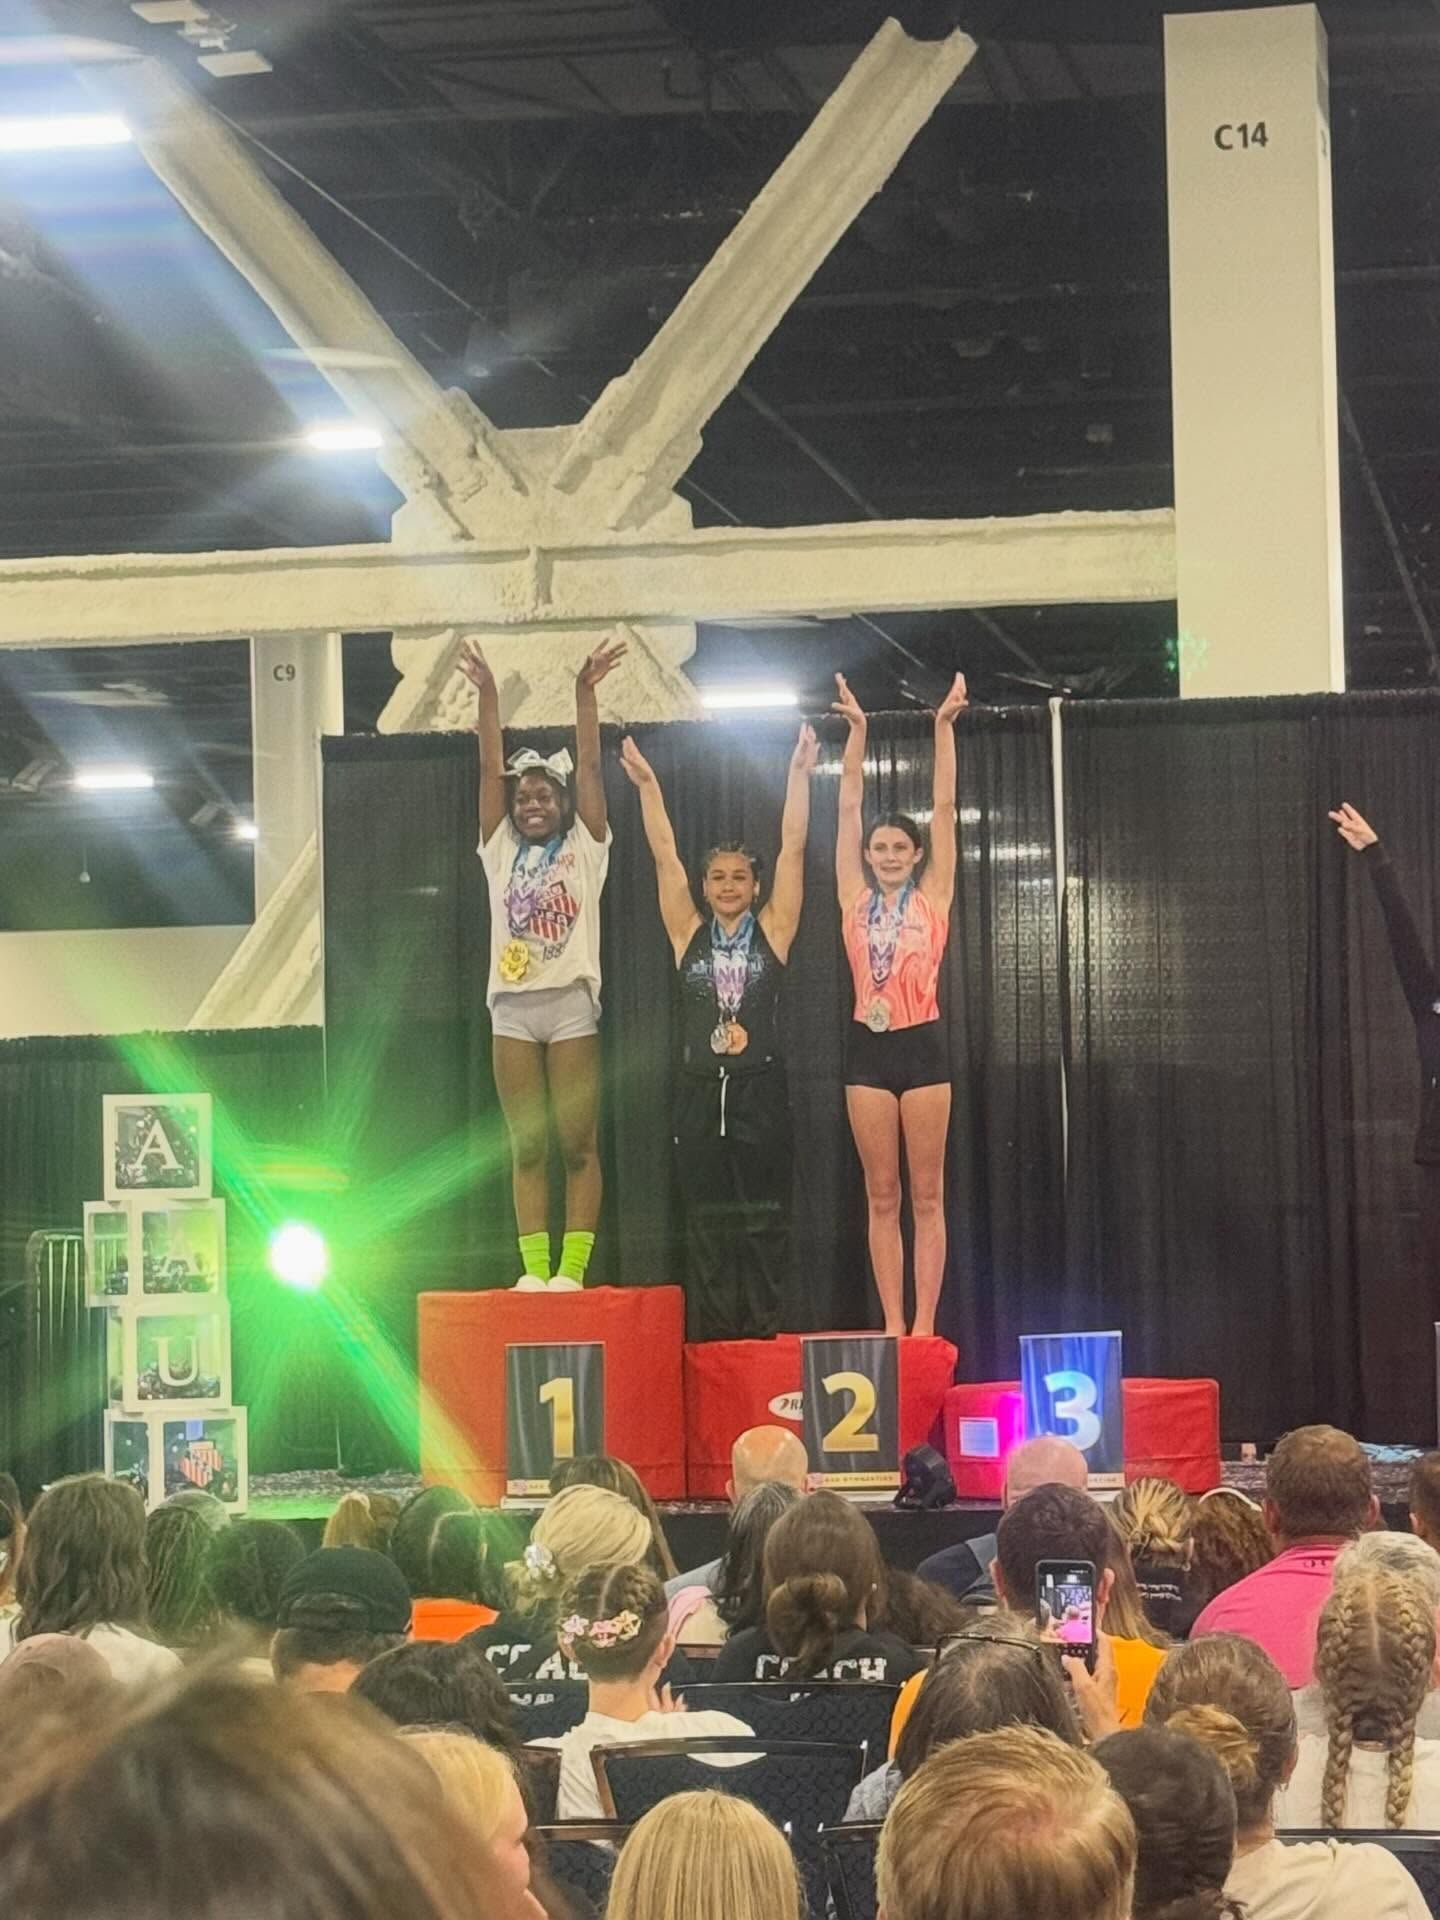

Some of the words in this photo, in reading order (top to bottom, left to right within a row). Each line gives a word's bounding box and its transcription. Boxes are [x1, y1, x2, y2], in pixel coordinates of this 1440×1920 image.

[1213, 121, 1269, 151] C14
[273, 664, 296, 682] C9
[135, 1119, 185, 1169] A
[151, 1335, 201, 1388] U
[539, 1377, 575, 1459] 1
[821, 1370, 879, 1452] 2
[1043, 1370, 1101, 1452] 3
